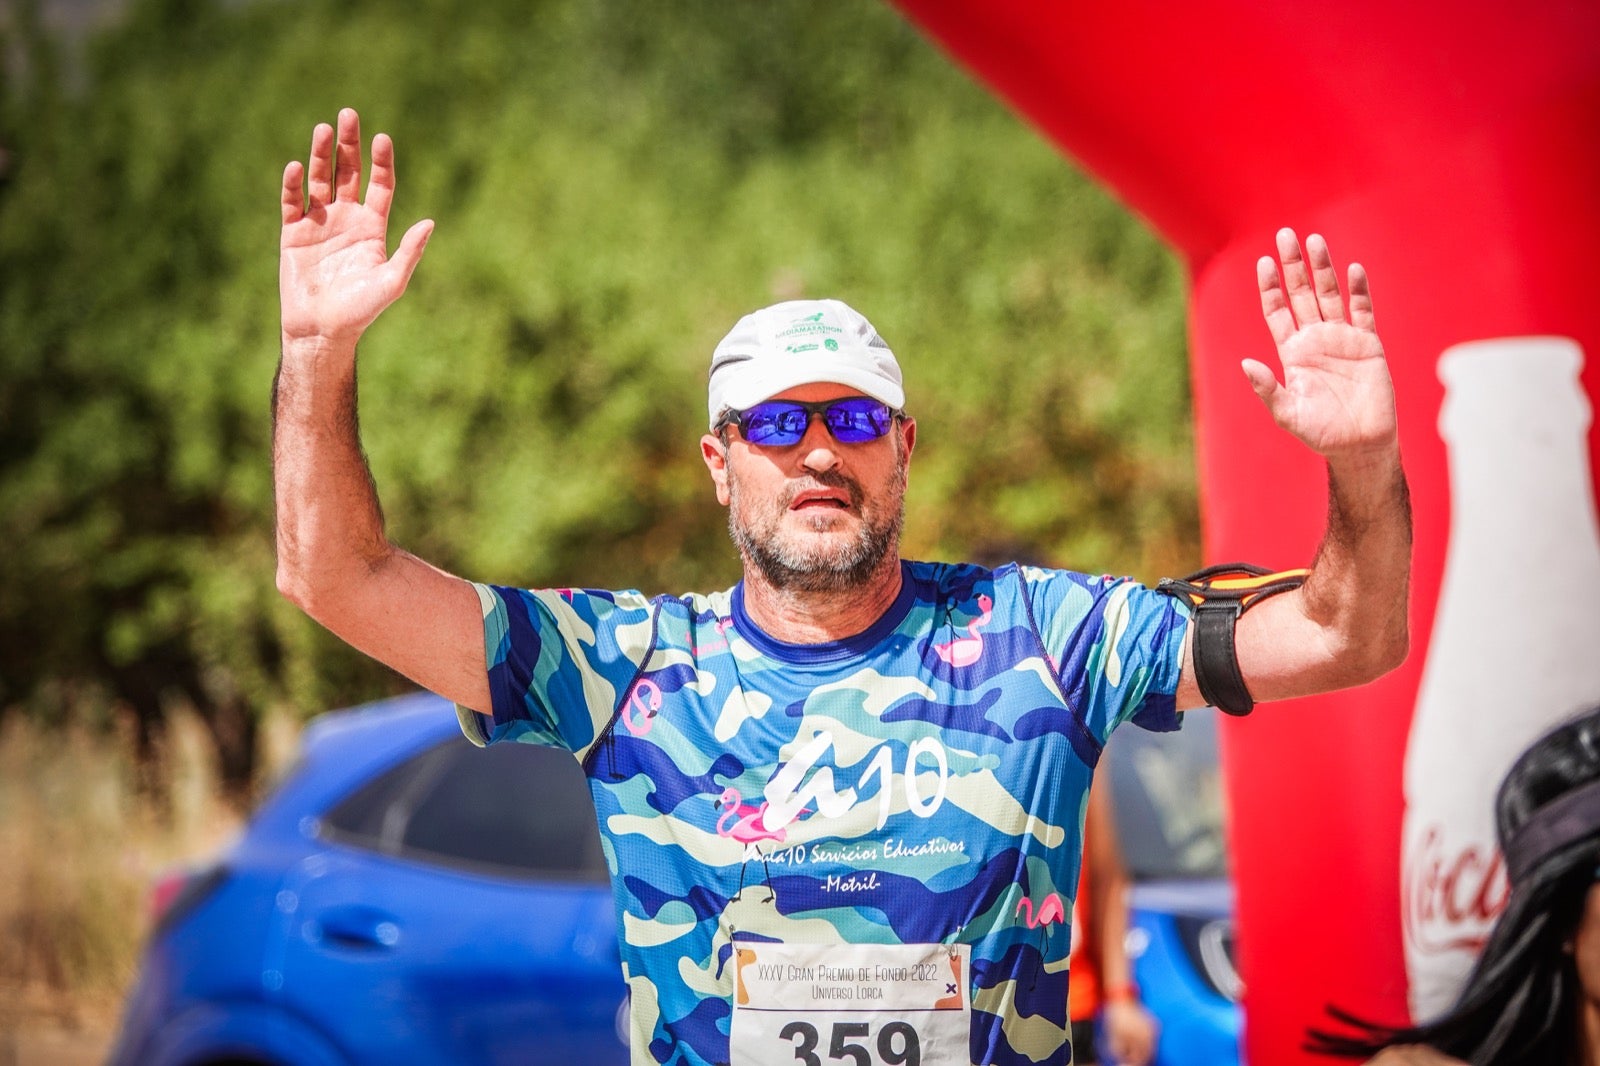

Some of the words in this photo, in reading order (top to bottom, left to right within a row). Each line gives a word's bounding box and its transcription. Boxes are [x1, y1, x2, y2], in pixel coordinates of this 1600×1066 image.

[811, 844, 878, 863] Servicios
[883, 836, 965, 859] Educativos
[758, 965, 783, 981] XXXV
[911, 964, 938, 981] 2022
[778, 1021, 922, 1066] 359
